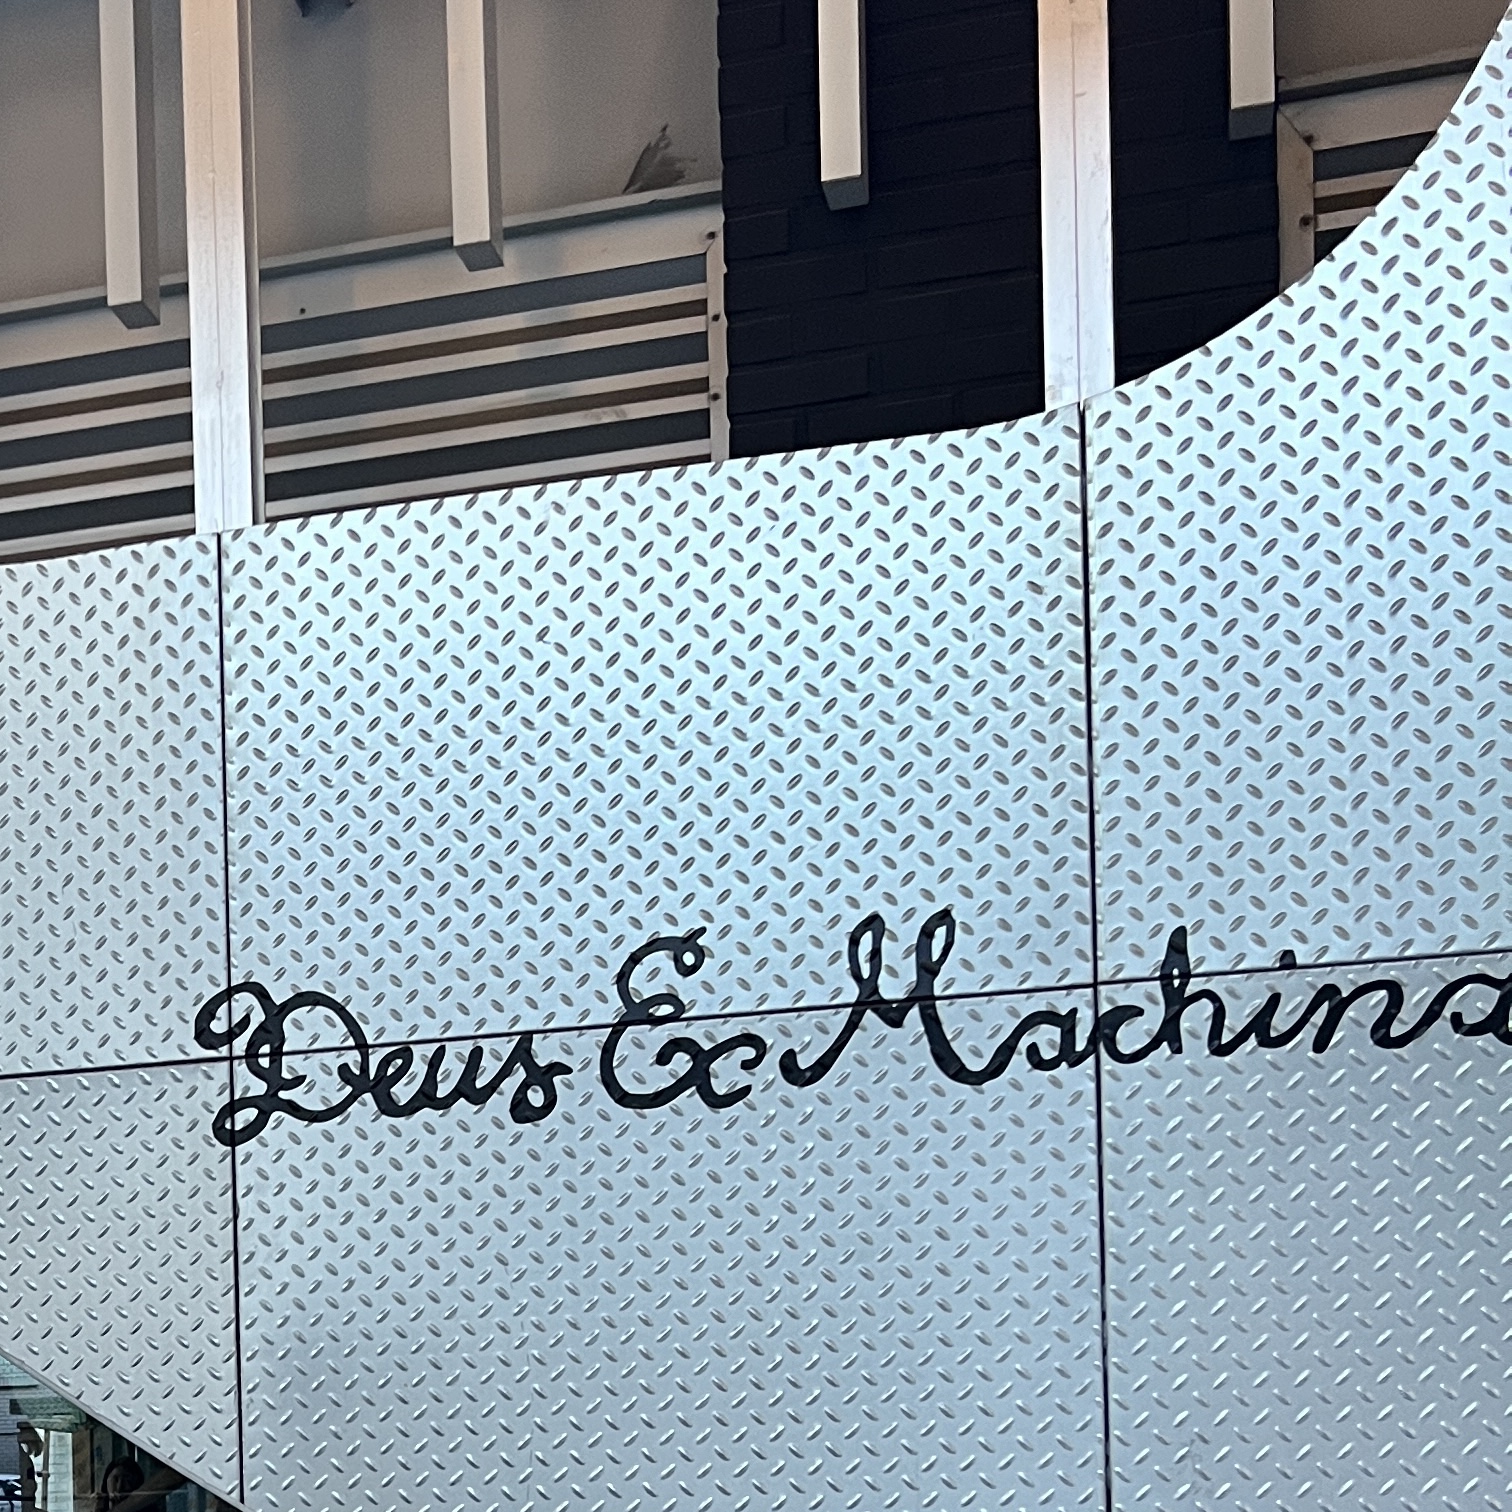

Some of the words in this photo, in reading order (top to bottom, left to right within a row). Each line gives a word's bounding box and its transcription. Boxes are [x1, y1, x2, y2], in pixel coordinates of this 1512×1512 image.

[194, 981, 573, 1147] Deus
[600, 926, 767, 1109] Ex
[778, 904, 1512, 1087] Machina
